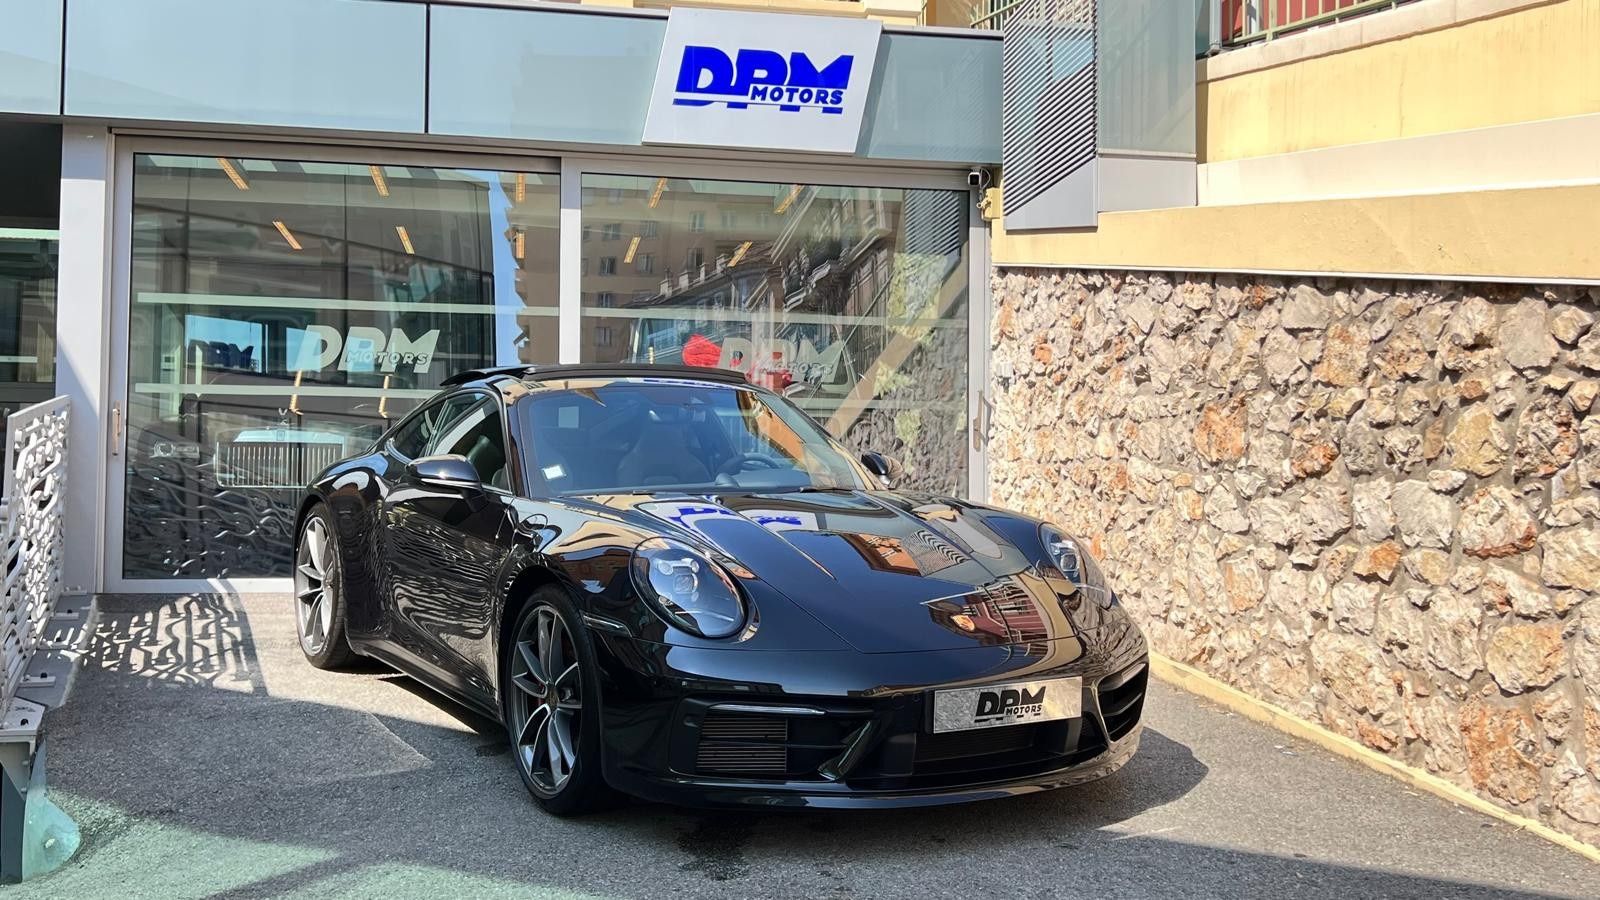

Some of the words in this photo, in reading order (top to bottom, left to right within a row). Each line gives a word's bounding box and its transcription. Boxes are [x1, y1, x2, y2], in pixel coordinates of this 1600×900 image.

[672, 45, 854, 114] DPM
[750, 86, 844, 105] MOTORS
[295, 325, 441, 374] DPM
[346, 350, 429, 365] MOTORS
[719, 337, 845, 384] DPM
[974, 686, 1046, 723] DPM
[1005, 704, 1043, 716] MOTORS
